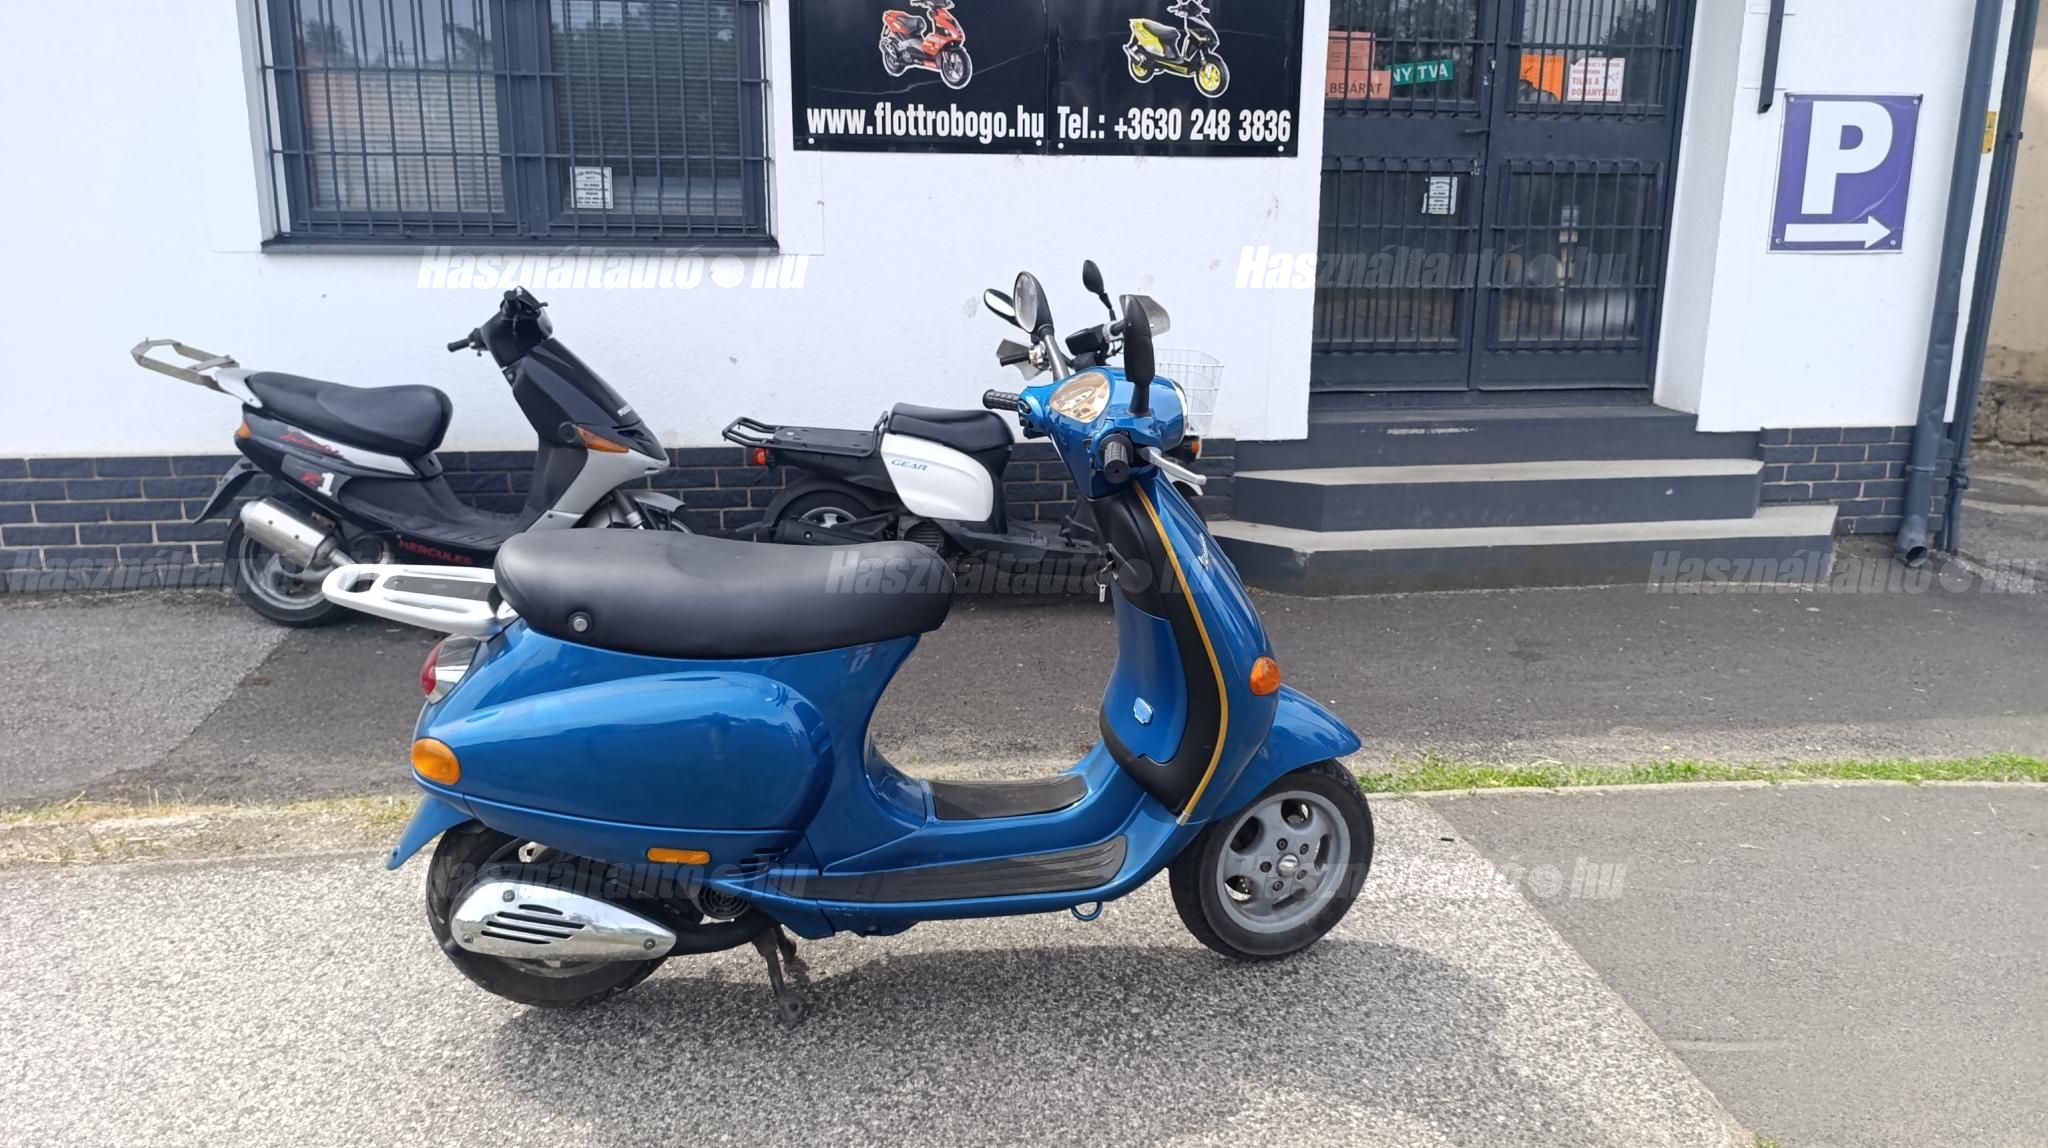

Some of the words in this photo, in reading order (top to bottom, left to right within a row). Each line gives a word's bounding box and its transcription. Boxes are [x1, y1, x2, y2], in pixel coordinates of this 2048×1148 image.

[1393, 63, 1449, 83] NYTVA
[1572, 77, 1592, 85] TILS
[1329, 79, 1384, 95] BEÁRAT
[806, 102, 1045, 144] www.flottrobogo.hu
[1057, 106, 1106, 140] Tel.:
[1114, 108, 1182, 141] +3630
[1190, 108, 1231, 142] 248
[1238, 110, 1292, 143] 3836
[1801, 100, 1894, 215] P
[891, 459, 928, 471] GEAR
[400, 539, 472, 566] HERCULES
